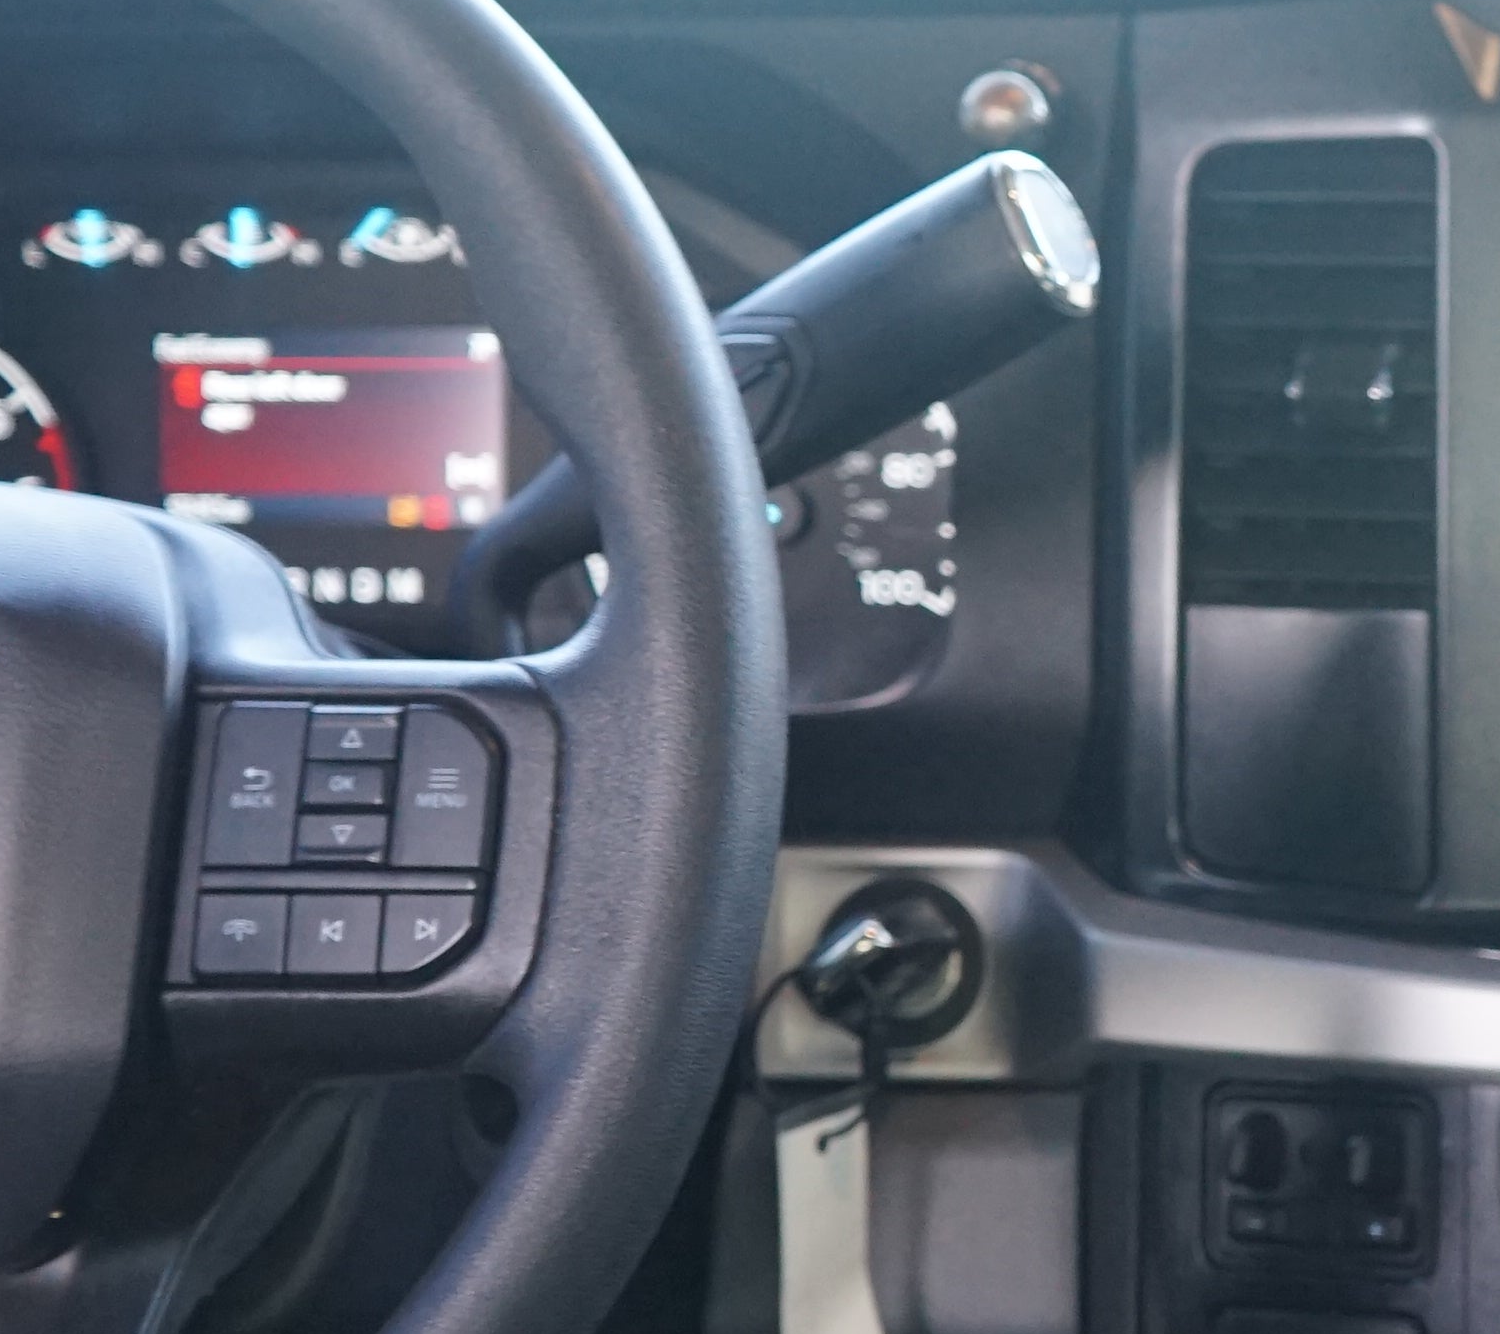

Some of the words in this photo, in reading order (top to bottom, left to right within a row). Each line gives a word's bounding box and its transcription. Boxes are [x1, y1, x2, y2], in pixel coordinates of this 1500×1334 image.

[880, 451, 938, 490] 80
[857, 568, 927, 607] 100
[328, 774, 357, 792] OK
